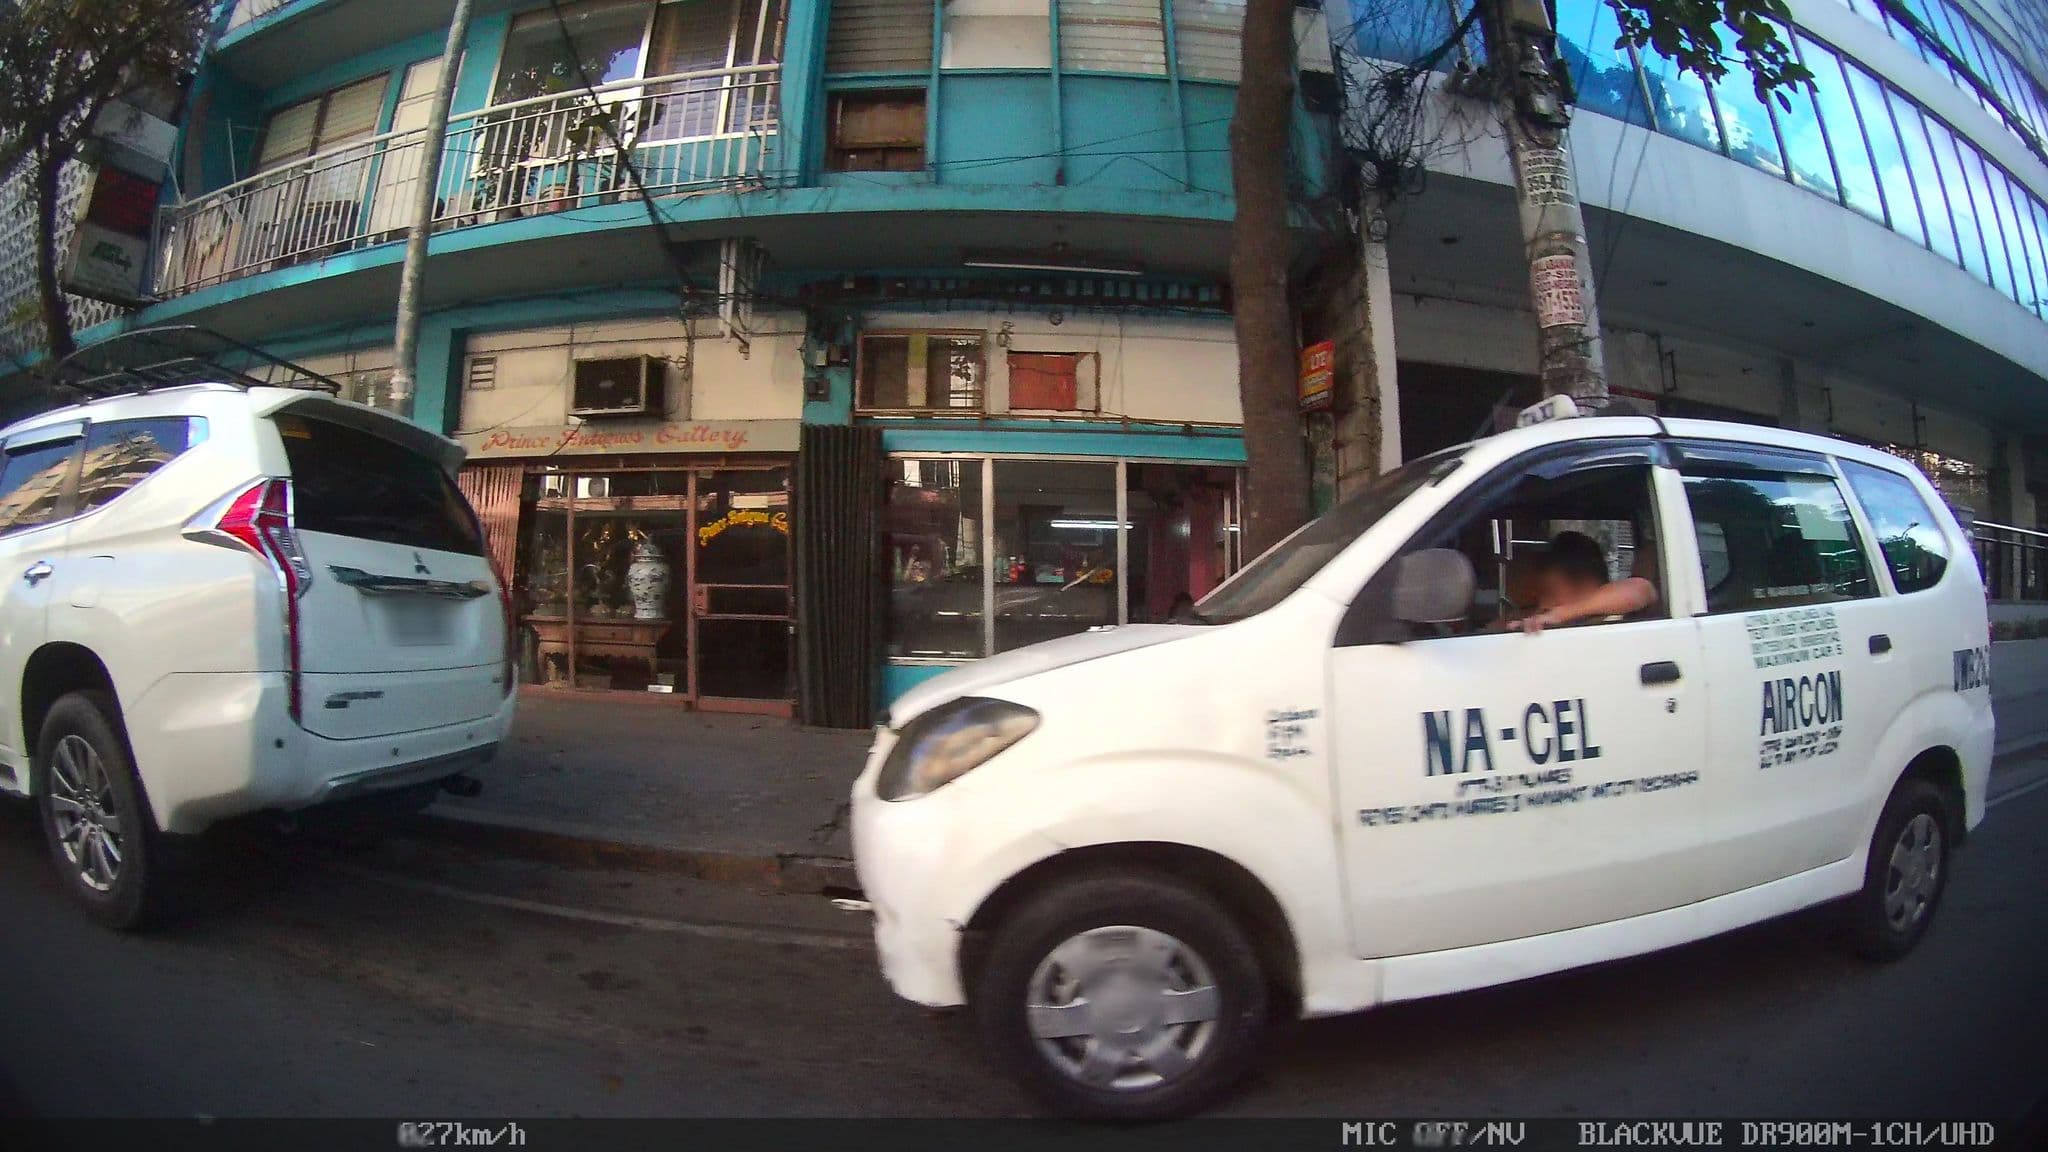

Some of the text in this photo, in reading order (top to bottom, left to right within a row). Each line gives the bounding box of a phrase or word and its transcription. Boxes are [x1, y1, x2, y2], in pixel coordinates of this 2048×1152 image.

[481, 430, 549, 452] Prince
[1421, 697, 1601, 776] NA-CEL
[1759, 670, 1843, 737] AIRCON
